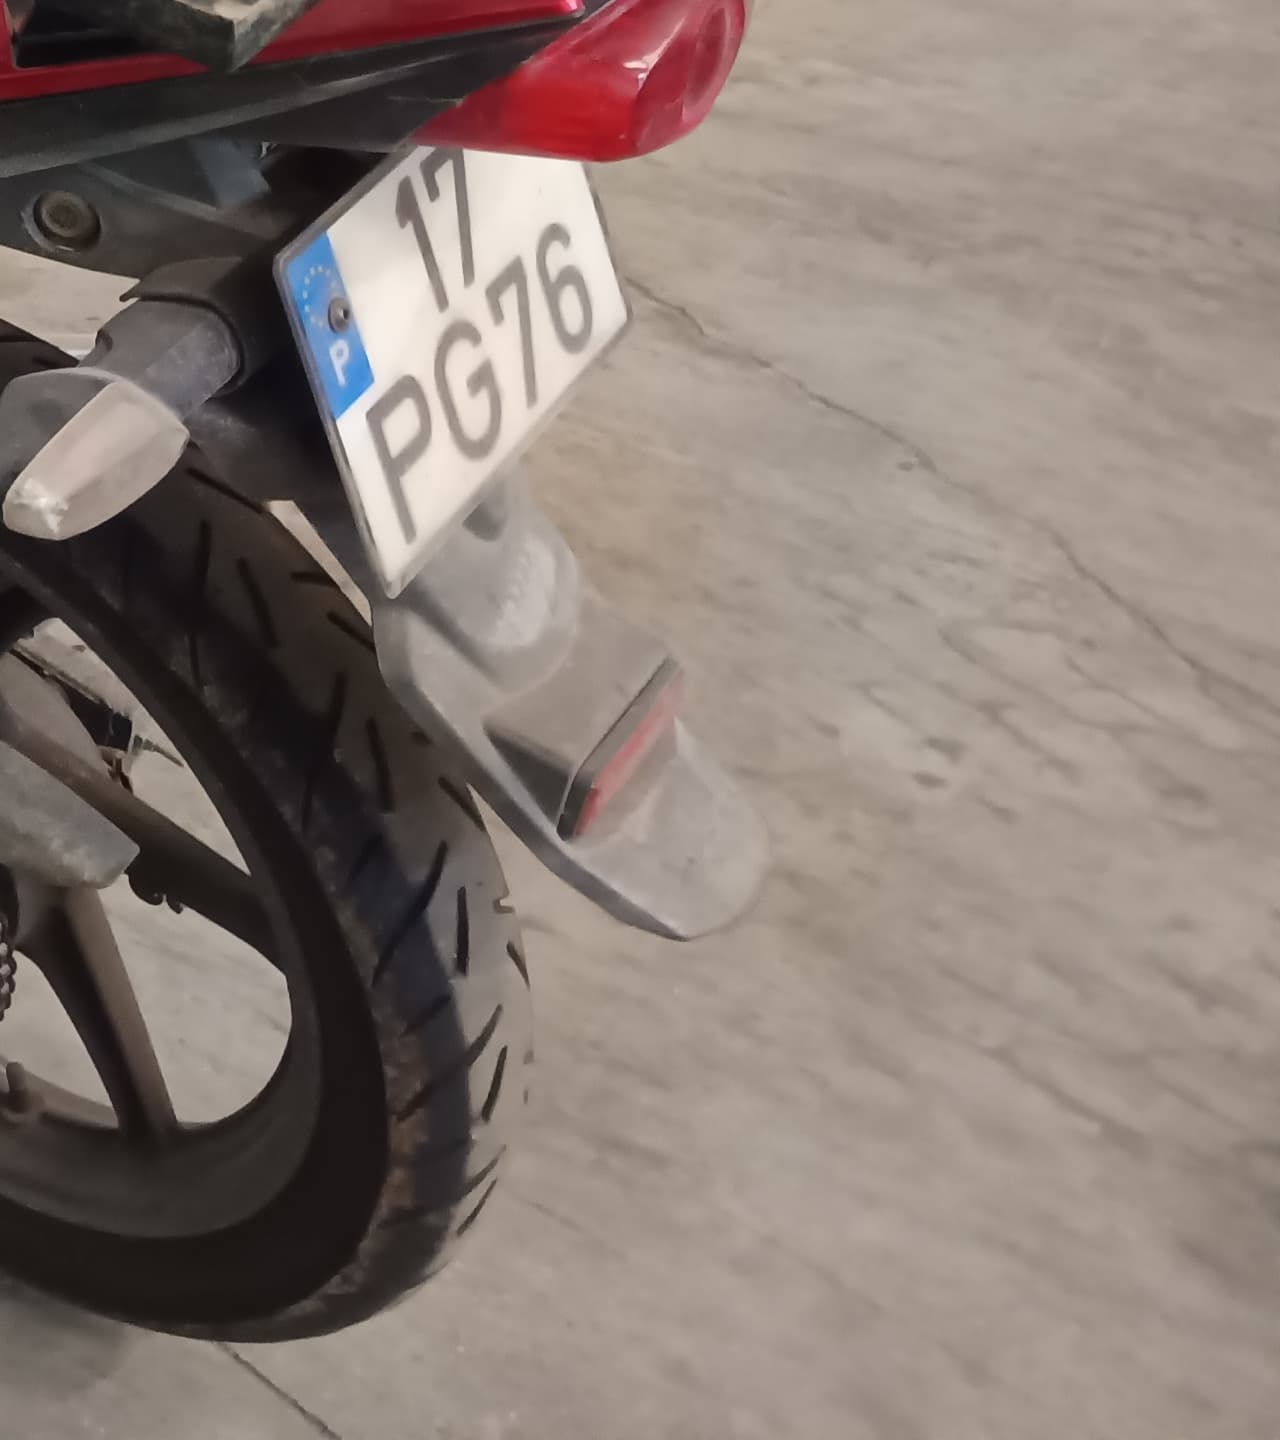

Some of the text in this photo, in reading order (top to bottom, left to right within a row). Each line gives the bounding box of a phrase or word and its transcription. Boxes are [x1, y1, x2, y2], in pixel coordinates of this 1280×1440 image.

[394, 147, 475, 312] 17
[328, 340, 351, 387] P
[366, 222, 593, 544] PG76
